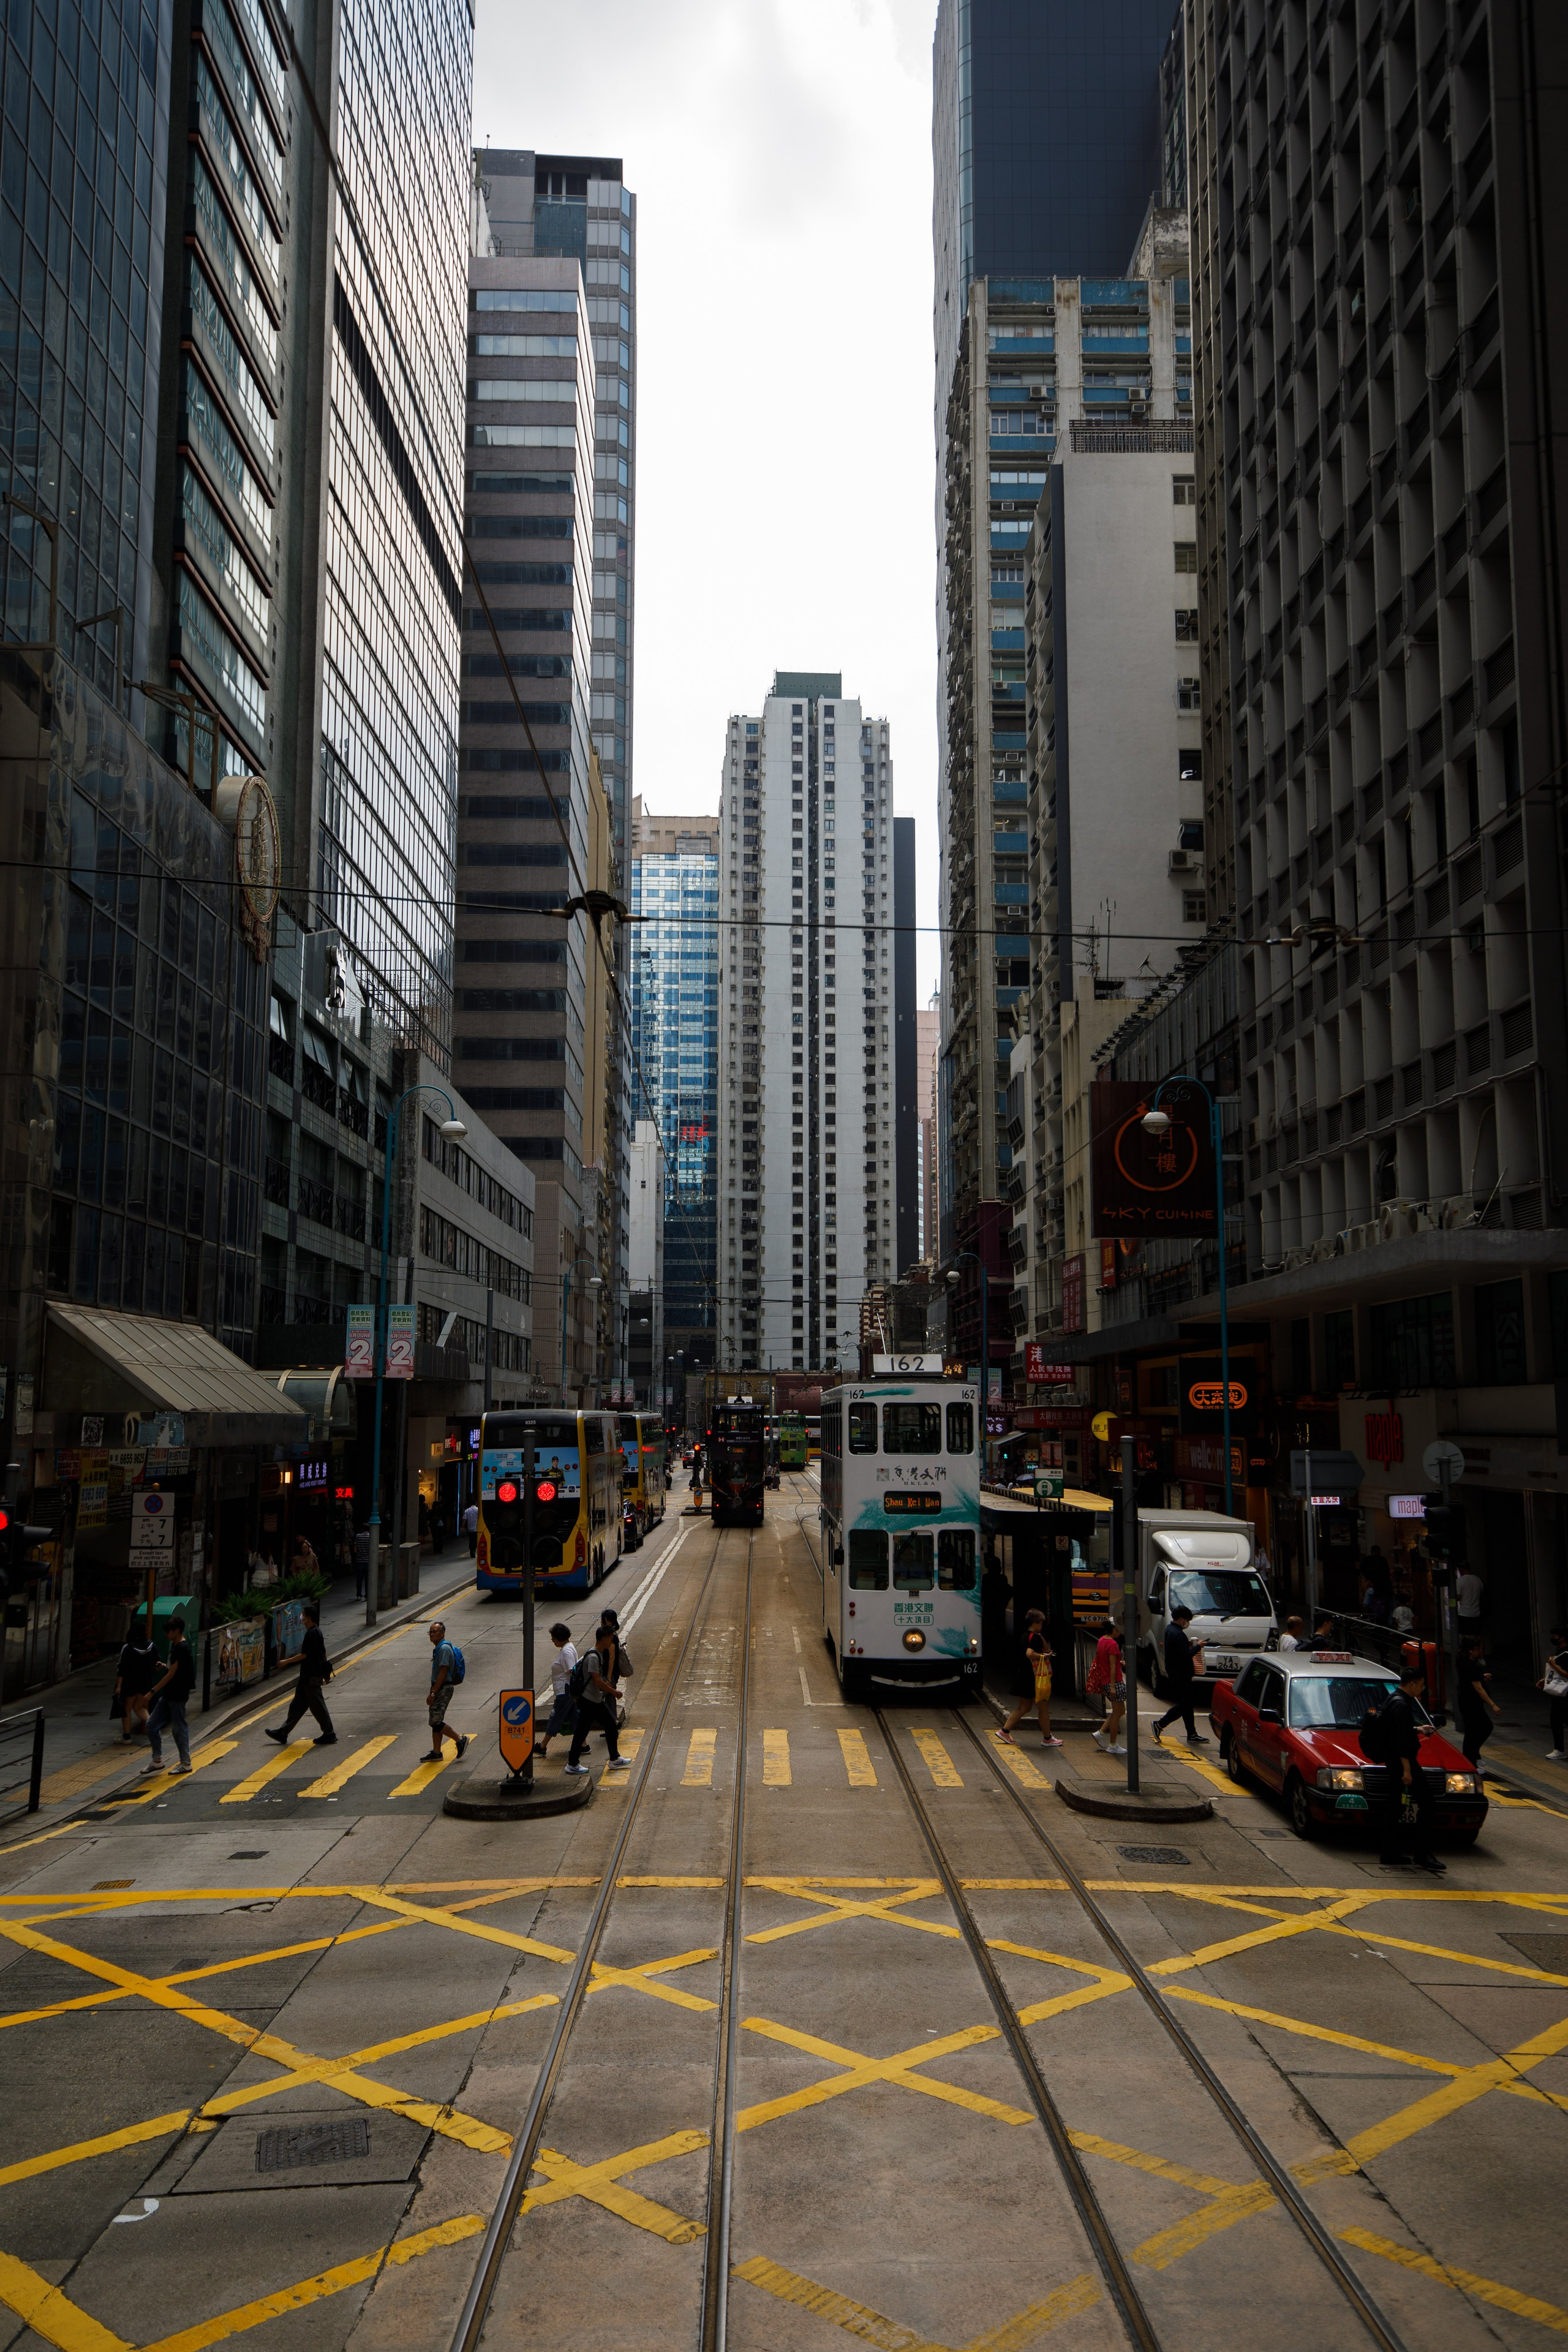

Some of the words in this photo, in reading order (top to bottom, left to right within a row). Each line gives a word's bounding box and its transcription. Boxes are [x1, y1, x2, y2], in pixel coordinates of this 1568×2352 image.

[1102, 1207, 1152, 1219] SKY
[1156, 1210, 1215, 1219] CUISINE
[349, 1338, 371, 1365] 2
[390, 1340, 412, 1366] 2
[891, 1356, 925, 1371] 162
[850, 1390, 864, 1400] 162
[962, 1390, 974, 1399] 162
[989, 1386, 1001, 1399] 2
[1365, 1399, 1403, 1471] maple
[120, 1453, 133, 1464] 6655
[1189, 1439, 1224, 1471] wellcom
[81, 1487, 94, 1501] 9363
[335, 1488, 353, 1498] 文具
[92, 1502, 102, 1510] Lease
[885, 1498, 903, 1507] Shau
[907, 1498, 921, 1507] Kei
[925, 1498, 940, 1507] Wan
[78, 1512, 105, 1526] 27811682
[159, 1519, 166, 1529] 7
[158, 1535, 165, 1544] 7
[894, 1603, 933, 1613] 香港文聯
[964, 1663, 978, 1673] 162
